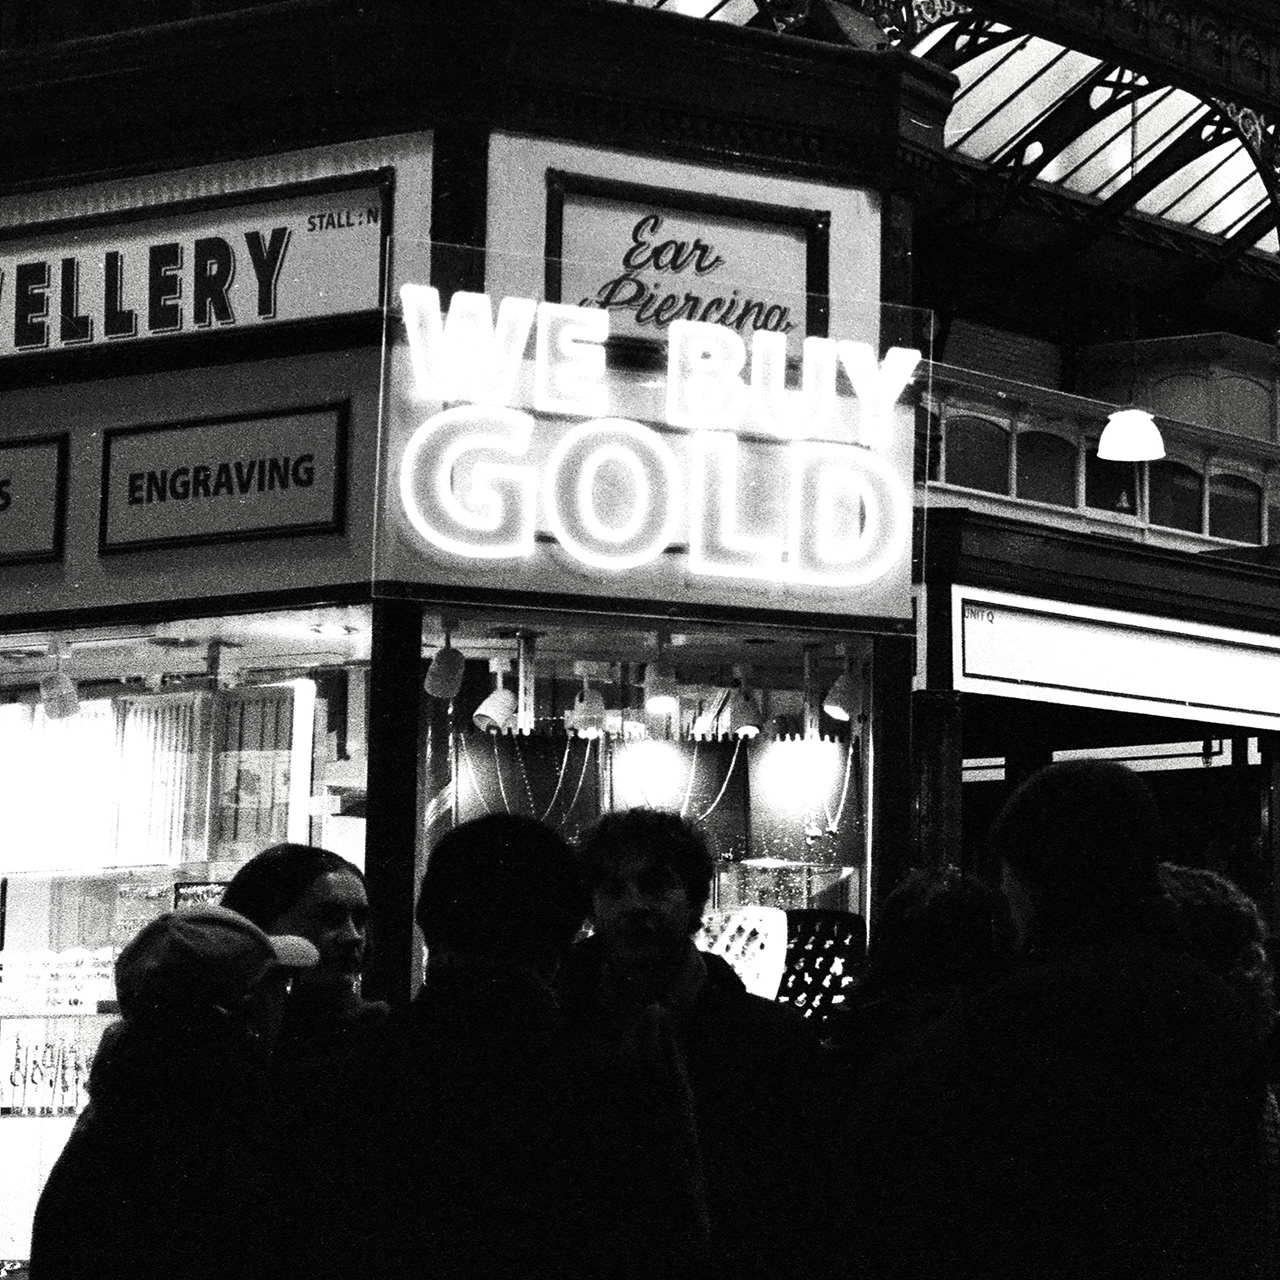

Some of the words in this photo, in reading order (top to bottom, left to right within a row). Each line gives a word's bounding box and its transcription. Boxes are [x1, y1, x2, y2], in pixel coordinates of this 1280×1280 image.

[0, 227, 292, 352] ELLERY
[623, 214, 726, 277] Ear
[400, 283, 610, 416] WE
[666, 320, 922, 442] BUY
[126, 455, 315, 506] ENGRAVING
[399, 404, 911, 587] GOLD
[963, 606, 984, 622] UNIT
[986, 610, 995, 625] Q
